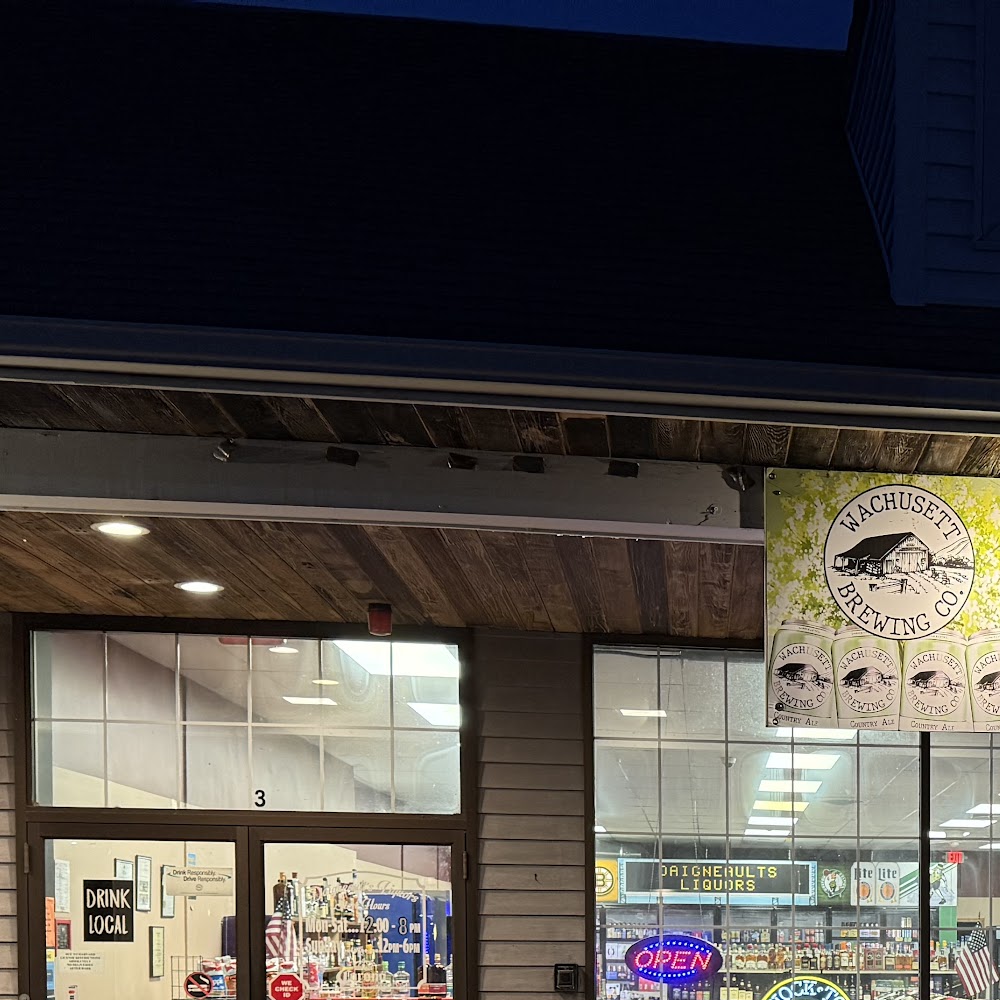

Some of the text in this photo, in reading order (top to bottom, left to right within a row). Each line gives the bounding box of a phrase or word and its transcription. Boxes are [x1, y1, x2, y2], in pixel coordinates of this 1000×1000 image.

[840, 491, 961, 540] WACHUSETT
[837, 581, 931, 636] BREWING
[778, 645, 832, 671] WACHUSETT
[840, 650, 894, 671] WACHUSETT
[910, 653, 963, 676] WACHUSETT
[773, 681, 814, 708] BREWING
[842, 690, 886, 712] BREWING
[908, 690, 949, 714] BREWING
[254, 789, 266, 808] 3
[681, 879, 756, 892] LIQUORS
[86, 888, 131, 909] DRINK
[363, 897, 390, 910] Hours
[88, 914, 129, 935] LOCAL
[398, 916, 408, 935] 8
[410, 922, 421, 933] PM
[635, 950, 712, 970] OPEN
